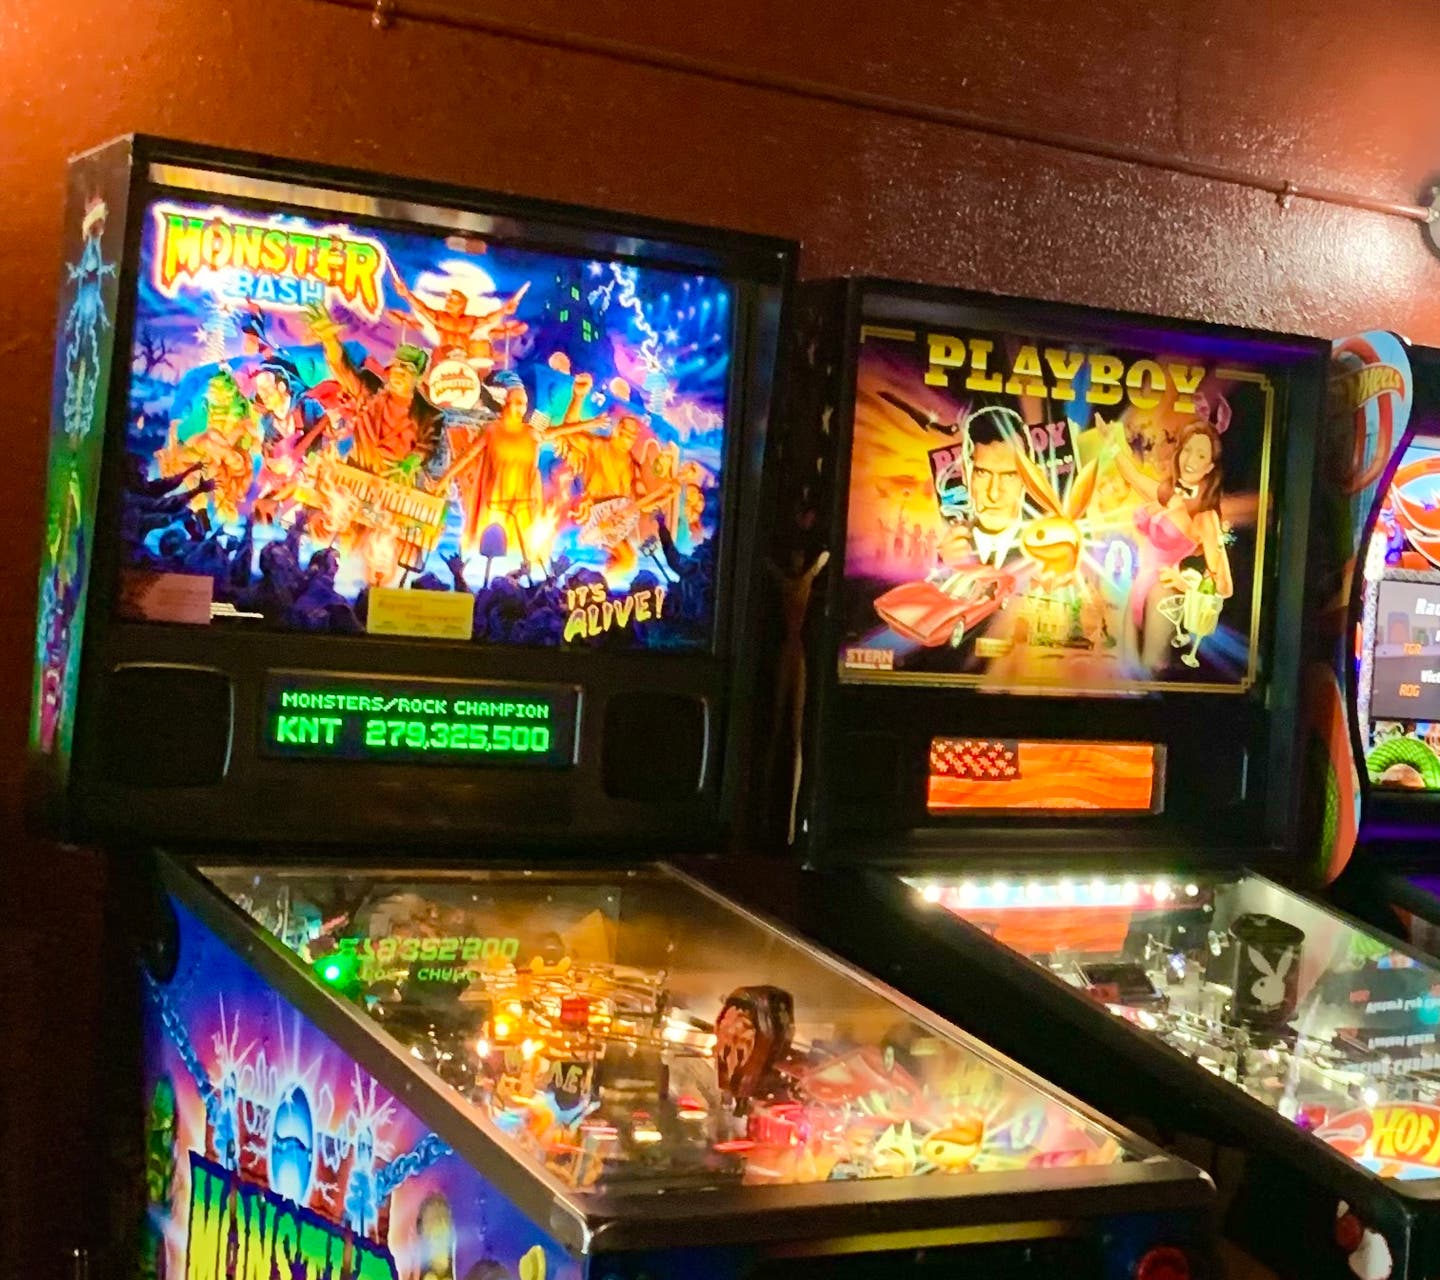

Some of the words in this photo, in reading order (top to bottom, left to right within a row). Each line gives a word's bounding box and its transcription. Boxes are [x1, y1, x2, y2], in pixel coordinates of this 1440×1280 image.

[161, 214, 380, 317] MONSTER
[228, 270, 324, 305] BASH
[924, 333, 1205, 414] PLAYBOY
[564, 586, 665, 642] ALIVE!
[846, 649, 893, 663] STERN
[282, 692, 447, 714] MONSTERS/ROCK
[454, 700, 549, 719] CHAMPION
[277, 716, 342, 744] KNT
[365, 719, 550, 752] 279,325,500
